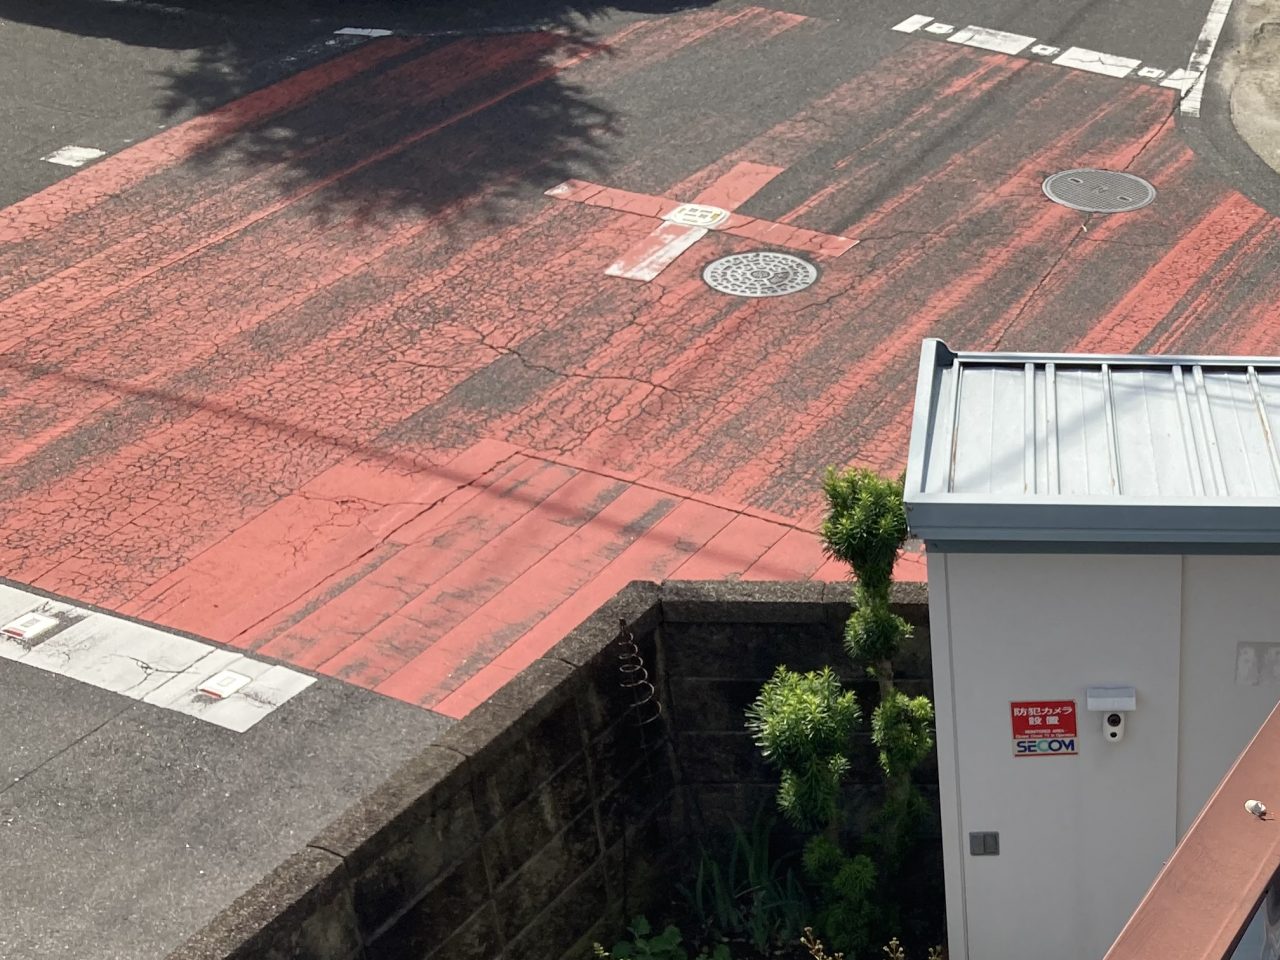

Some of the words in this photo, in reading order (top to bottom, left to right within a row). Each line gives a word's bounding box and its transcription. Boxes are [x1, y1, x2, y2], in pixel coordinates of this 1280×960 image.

[1013, 706, 1072, 716] 防犯カメラ
[1028, 716, 1059, 725] 設置
[1017, 739, 1074, 752] SECOM
